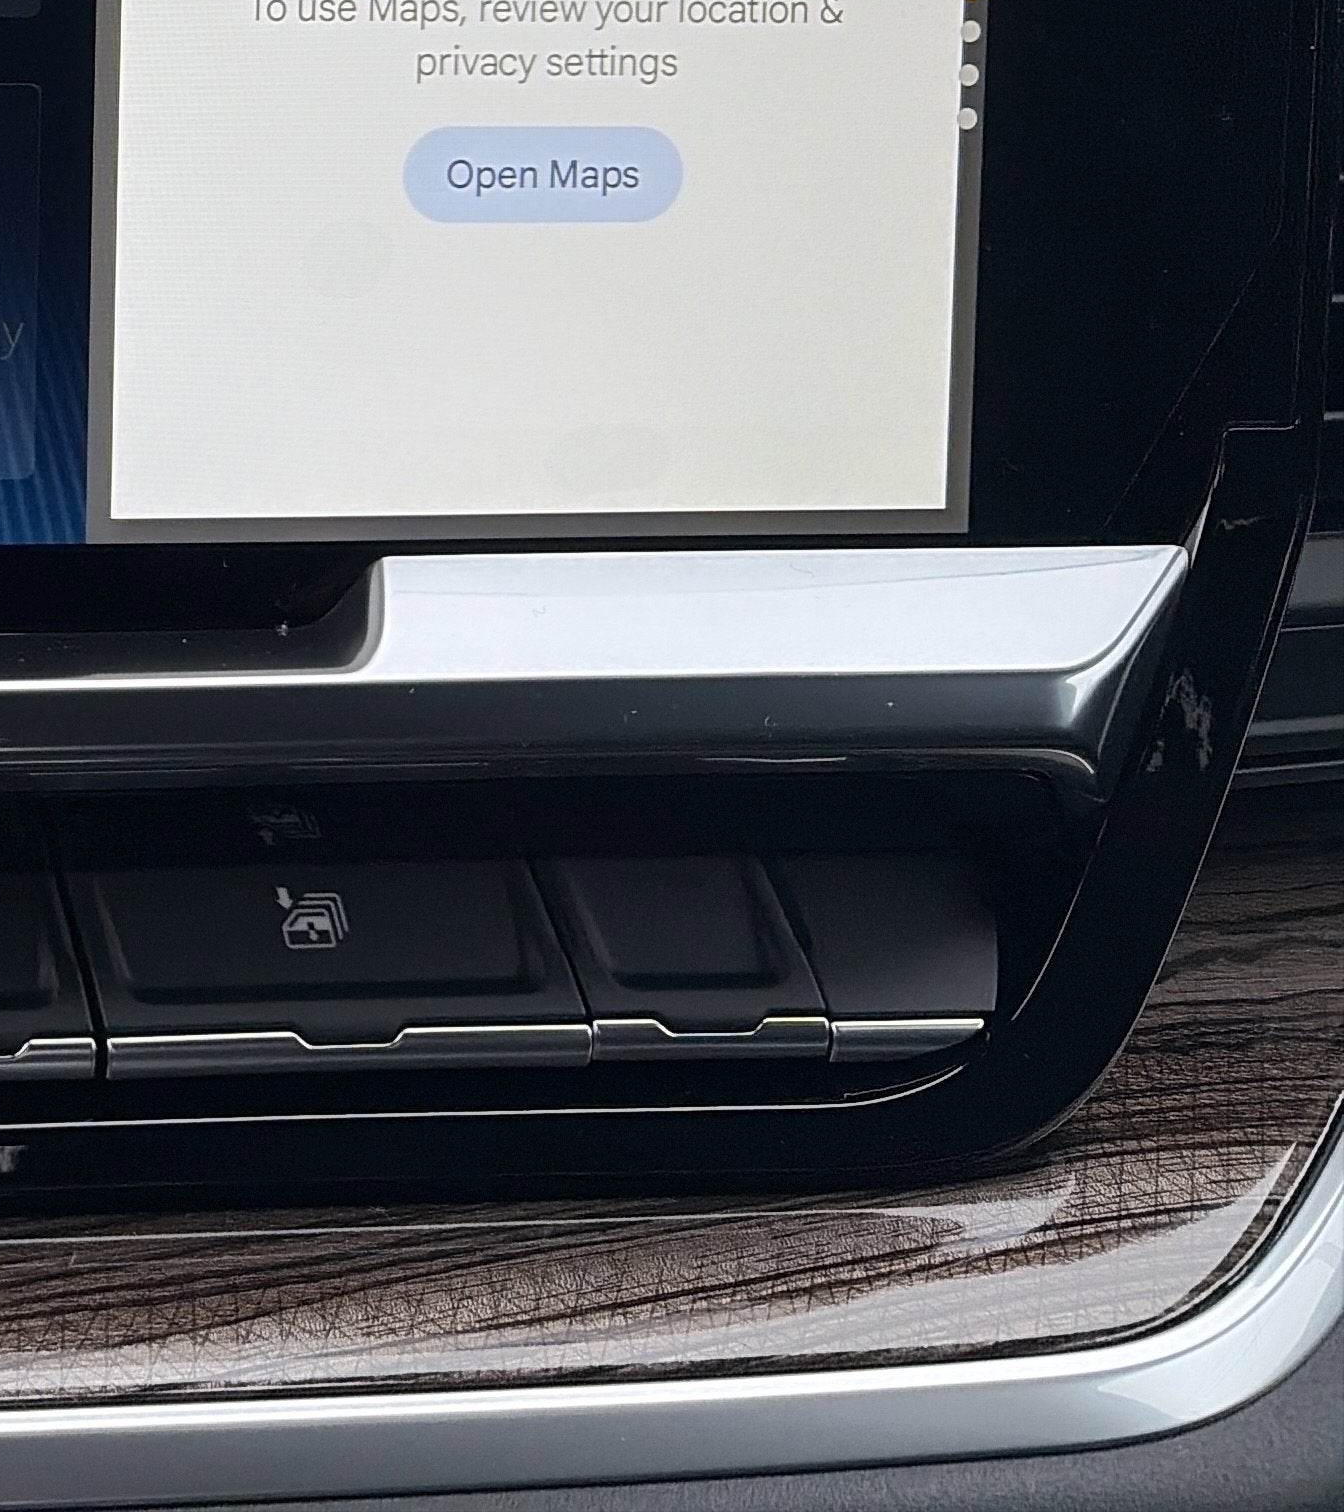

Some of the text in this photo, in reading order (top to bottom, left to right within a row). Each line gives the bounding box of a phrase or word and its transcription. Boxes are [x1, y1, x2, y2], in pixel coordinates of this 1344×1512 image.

[594, 0, 670, 32] your
[415, 44, 679, 86] privacy settings
[446, 158, 640, 197] Open Maps
